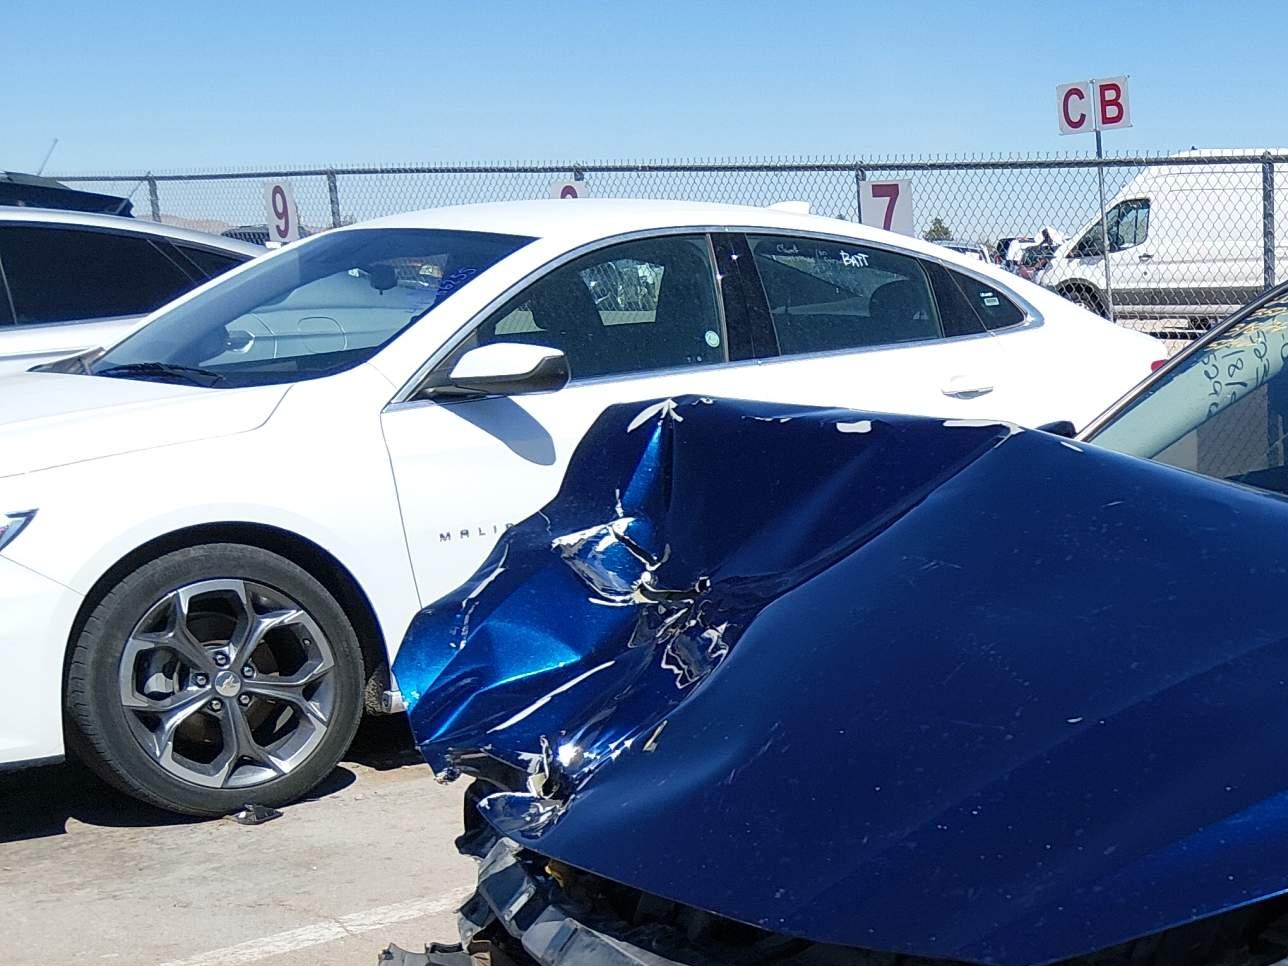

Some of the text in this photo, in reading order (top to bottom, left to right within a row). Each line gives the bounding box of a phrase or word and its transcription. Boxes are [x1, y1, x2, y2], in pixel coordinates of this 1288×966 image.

[1063, 88, 1086, 129] C
[1099, 83, 1124, 125] B
[272, 185, 289, 239] 9
[871, 184, 899, 231] 7
[839, 250, 869, 267] BATT
